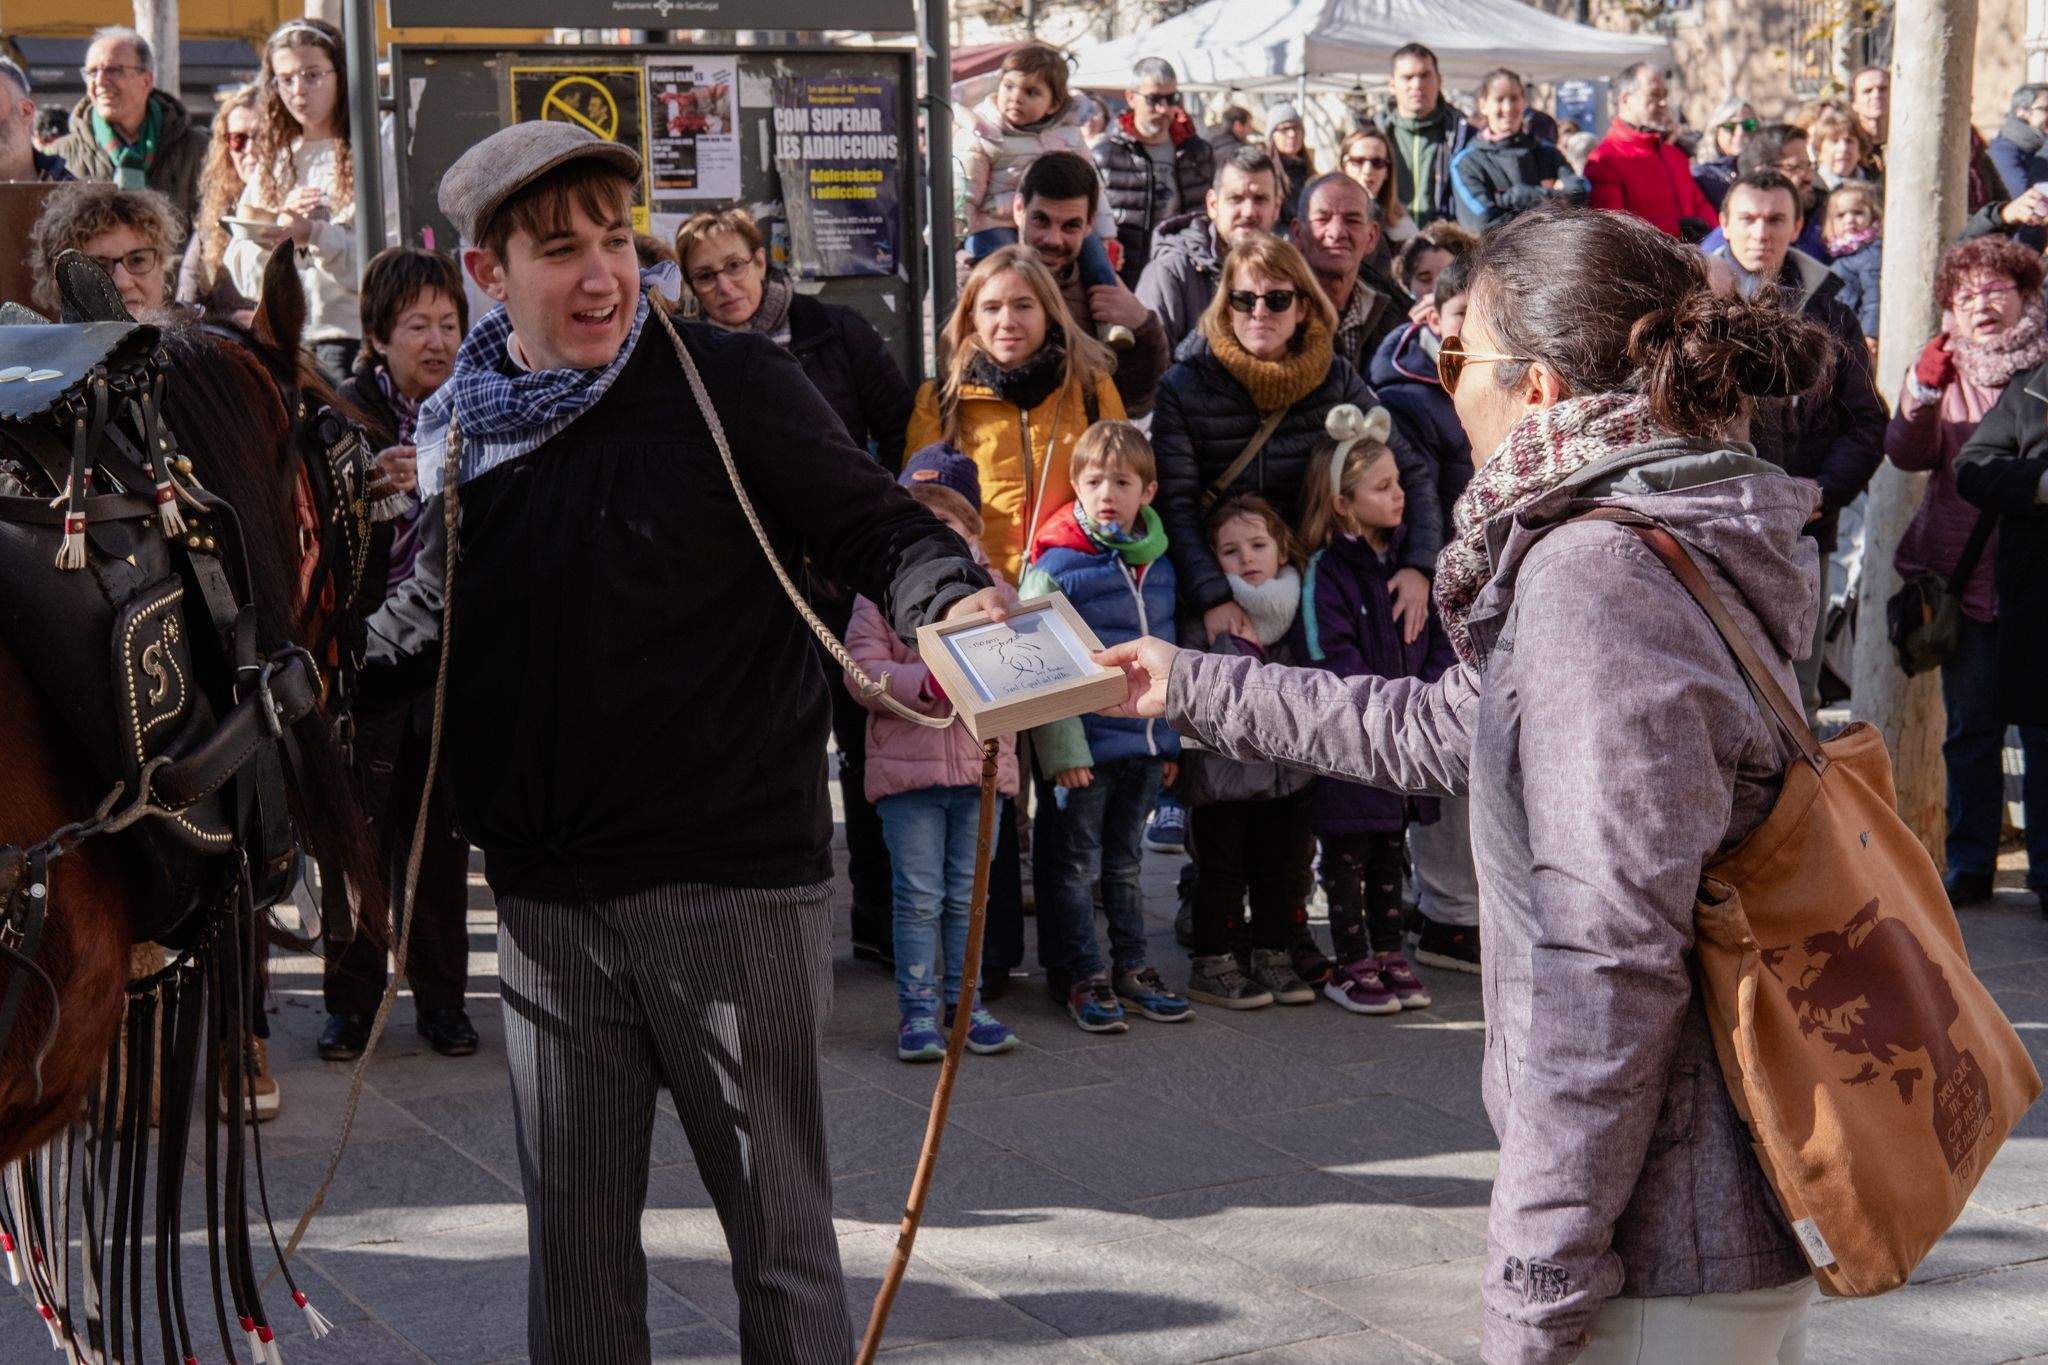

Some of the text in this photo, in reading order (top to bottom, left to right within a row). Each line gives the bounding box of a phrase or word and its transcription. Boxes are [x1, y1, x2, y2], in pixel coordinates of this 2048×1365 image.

[774, 108, 882, 132] COM SUPERAR
[776, 135, 898, 159] LES ADDICCIONS
[1530, 1264, 1568, 1282] PRO
[1531, 1279, 1571, 1297] TEST
